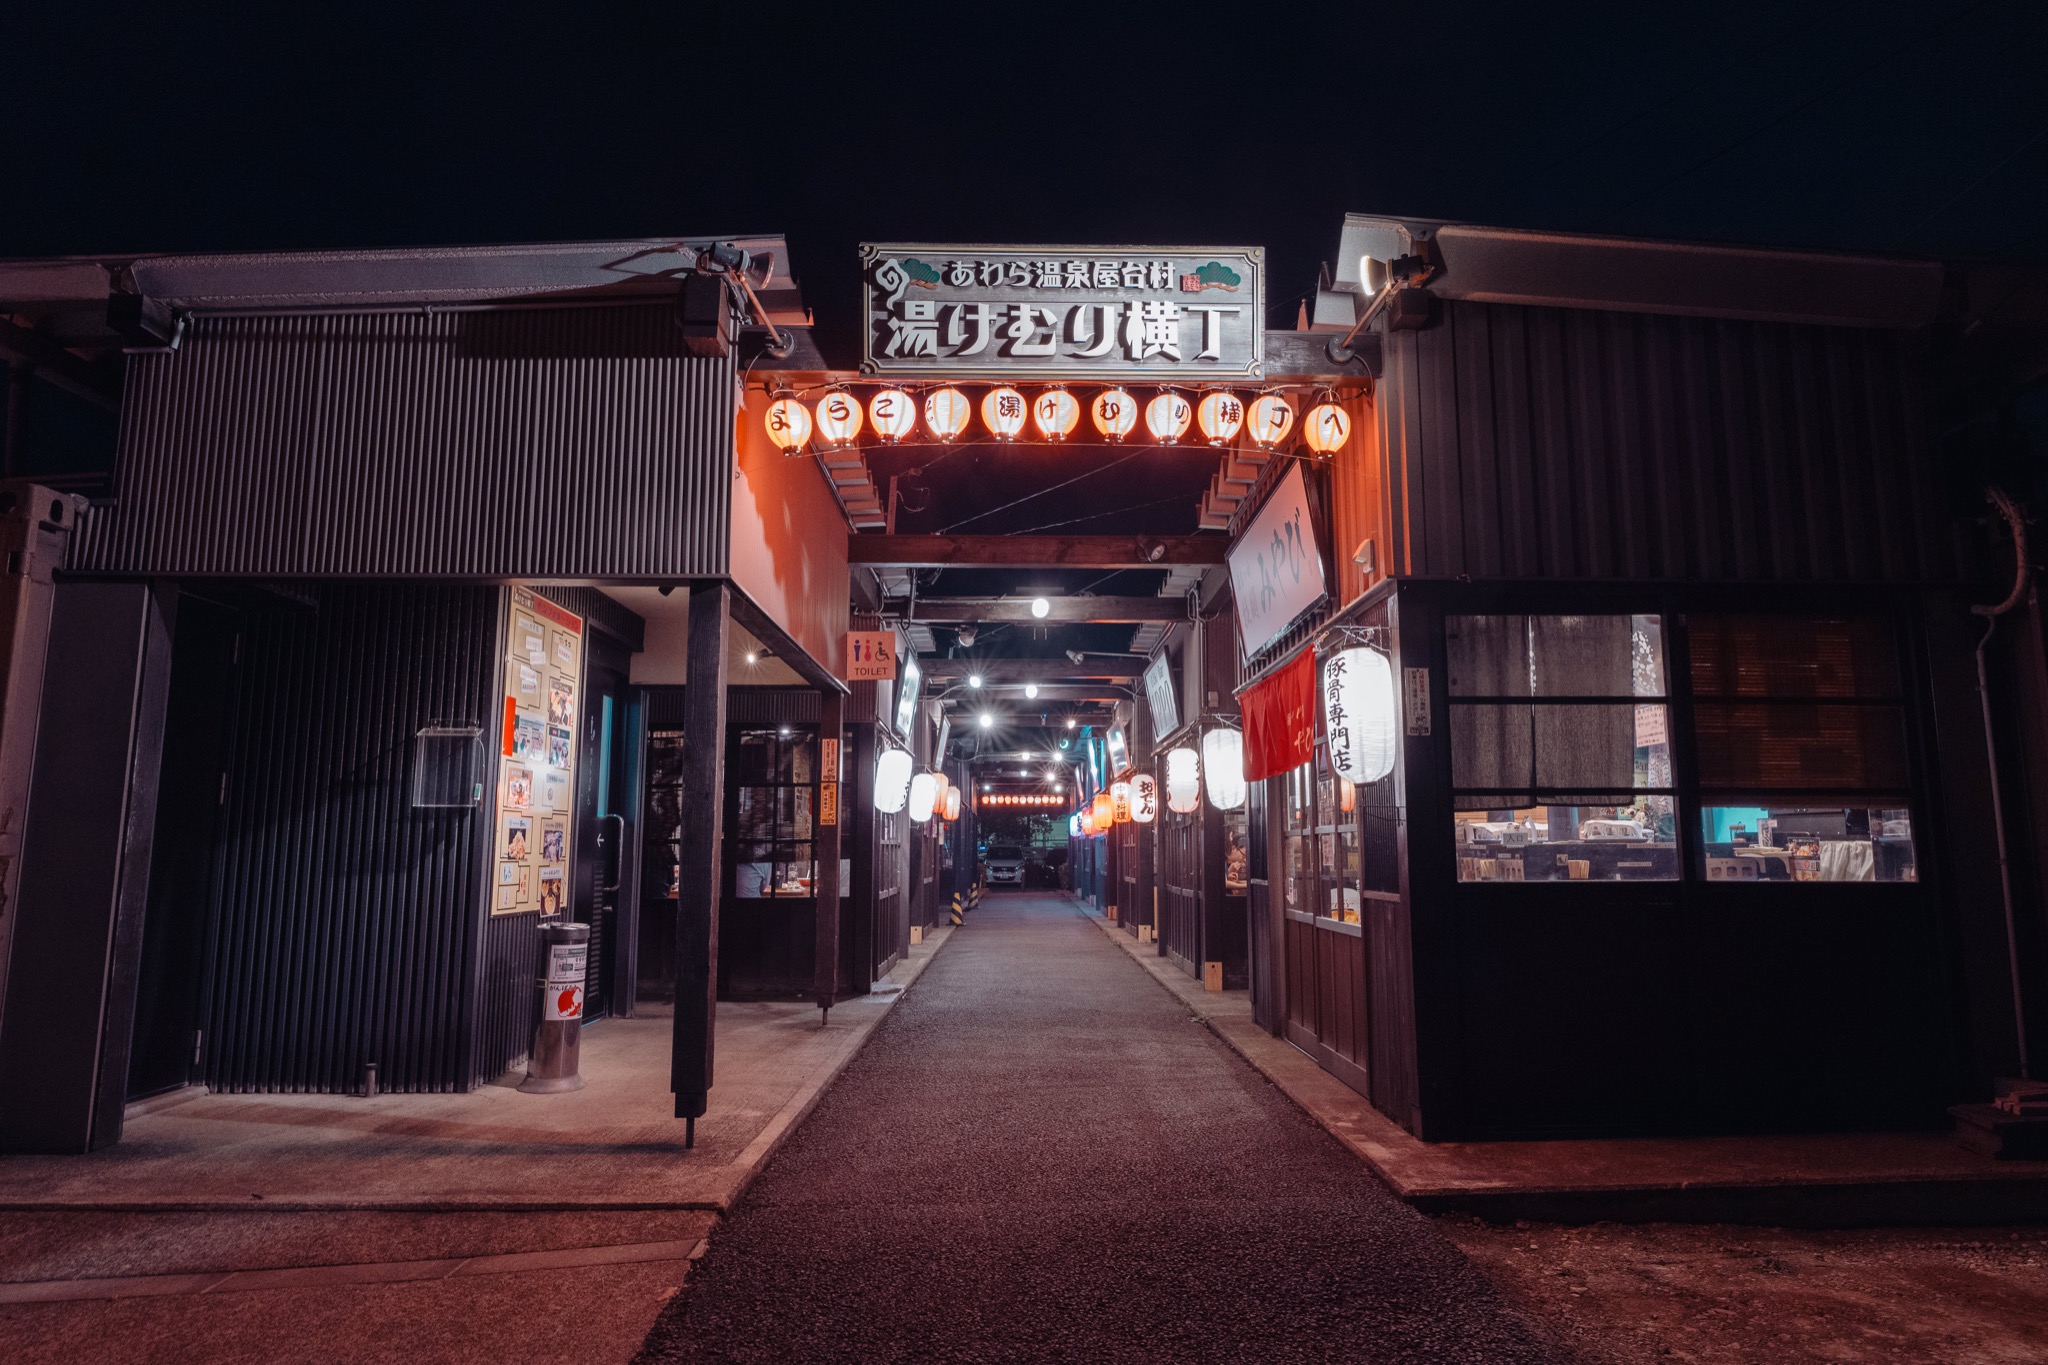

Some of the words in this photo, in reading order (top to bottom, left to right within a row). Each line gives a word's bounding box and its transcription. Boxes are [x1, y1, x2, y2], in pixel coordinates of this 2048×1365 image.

[950, 260, 1176, 290] あわら温泉屋台村
[885, 300, 1241, 362] 湯けむり横丁
[1258, 506, 1306, 614] みやび
[854, 667, 888, 676] TOILET
[1325, 657, 1353, 772] 豚骨専門店
[1139, 781, 1154, 815] おでん
[1506, 833, 1524, 843] 入口
